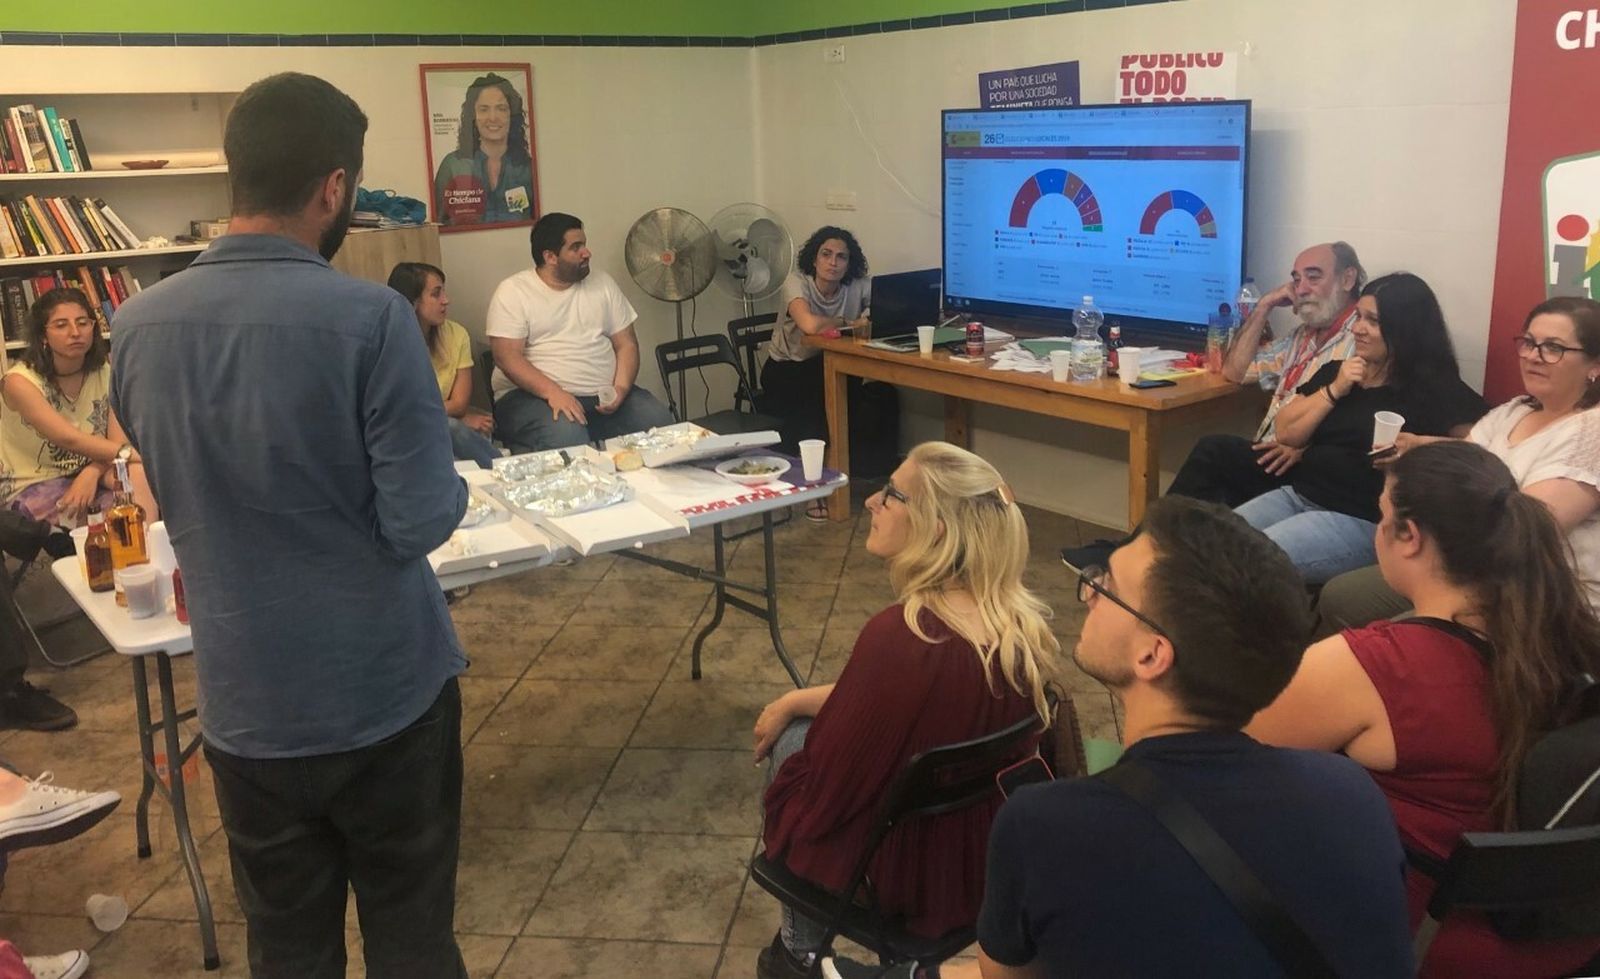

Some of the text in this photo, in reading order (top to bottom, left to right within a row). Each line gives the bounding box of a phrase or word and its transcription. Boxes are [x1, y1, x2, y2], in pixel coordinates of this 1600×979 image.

[988, 80, 1002, 90] UN
[1035, 72, 1057, 84] LUCHA
[1119, 69, 1187, 97] TODO
[989, 91, 1007, 103] POR
[1008, 88, 1024, 101] UNA
[984, 134, 996, 144] 26
[448, 196, 481, 205] Chiclana
